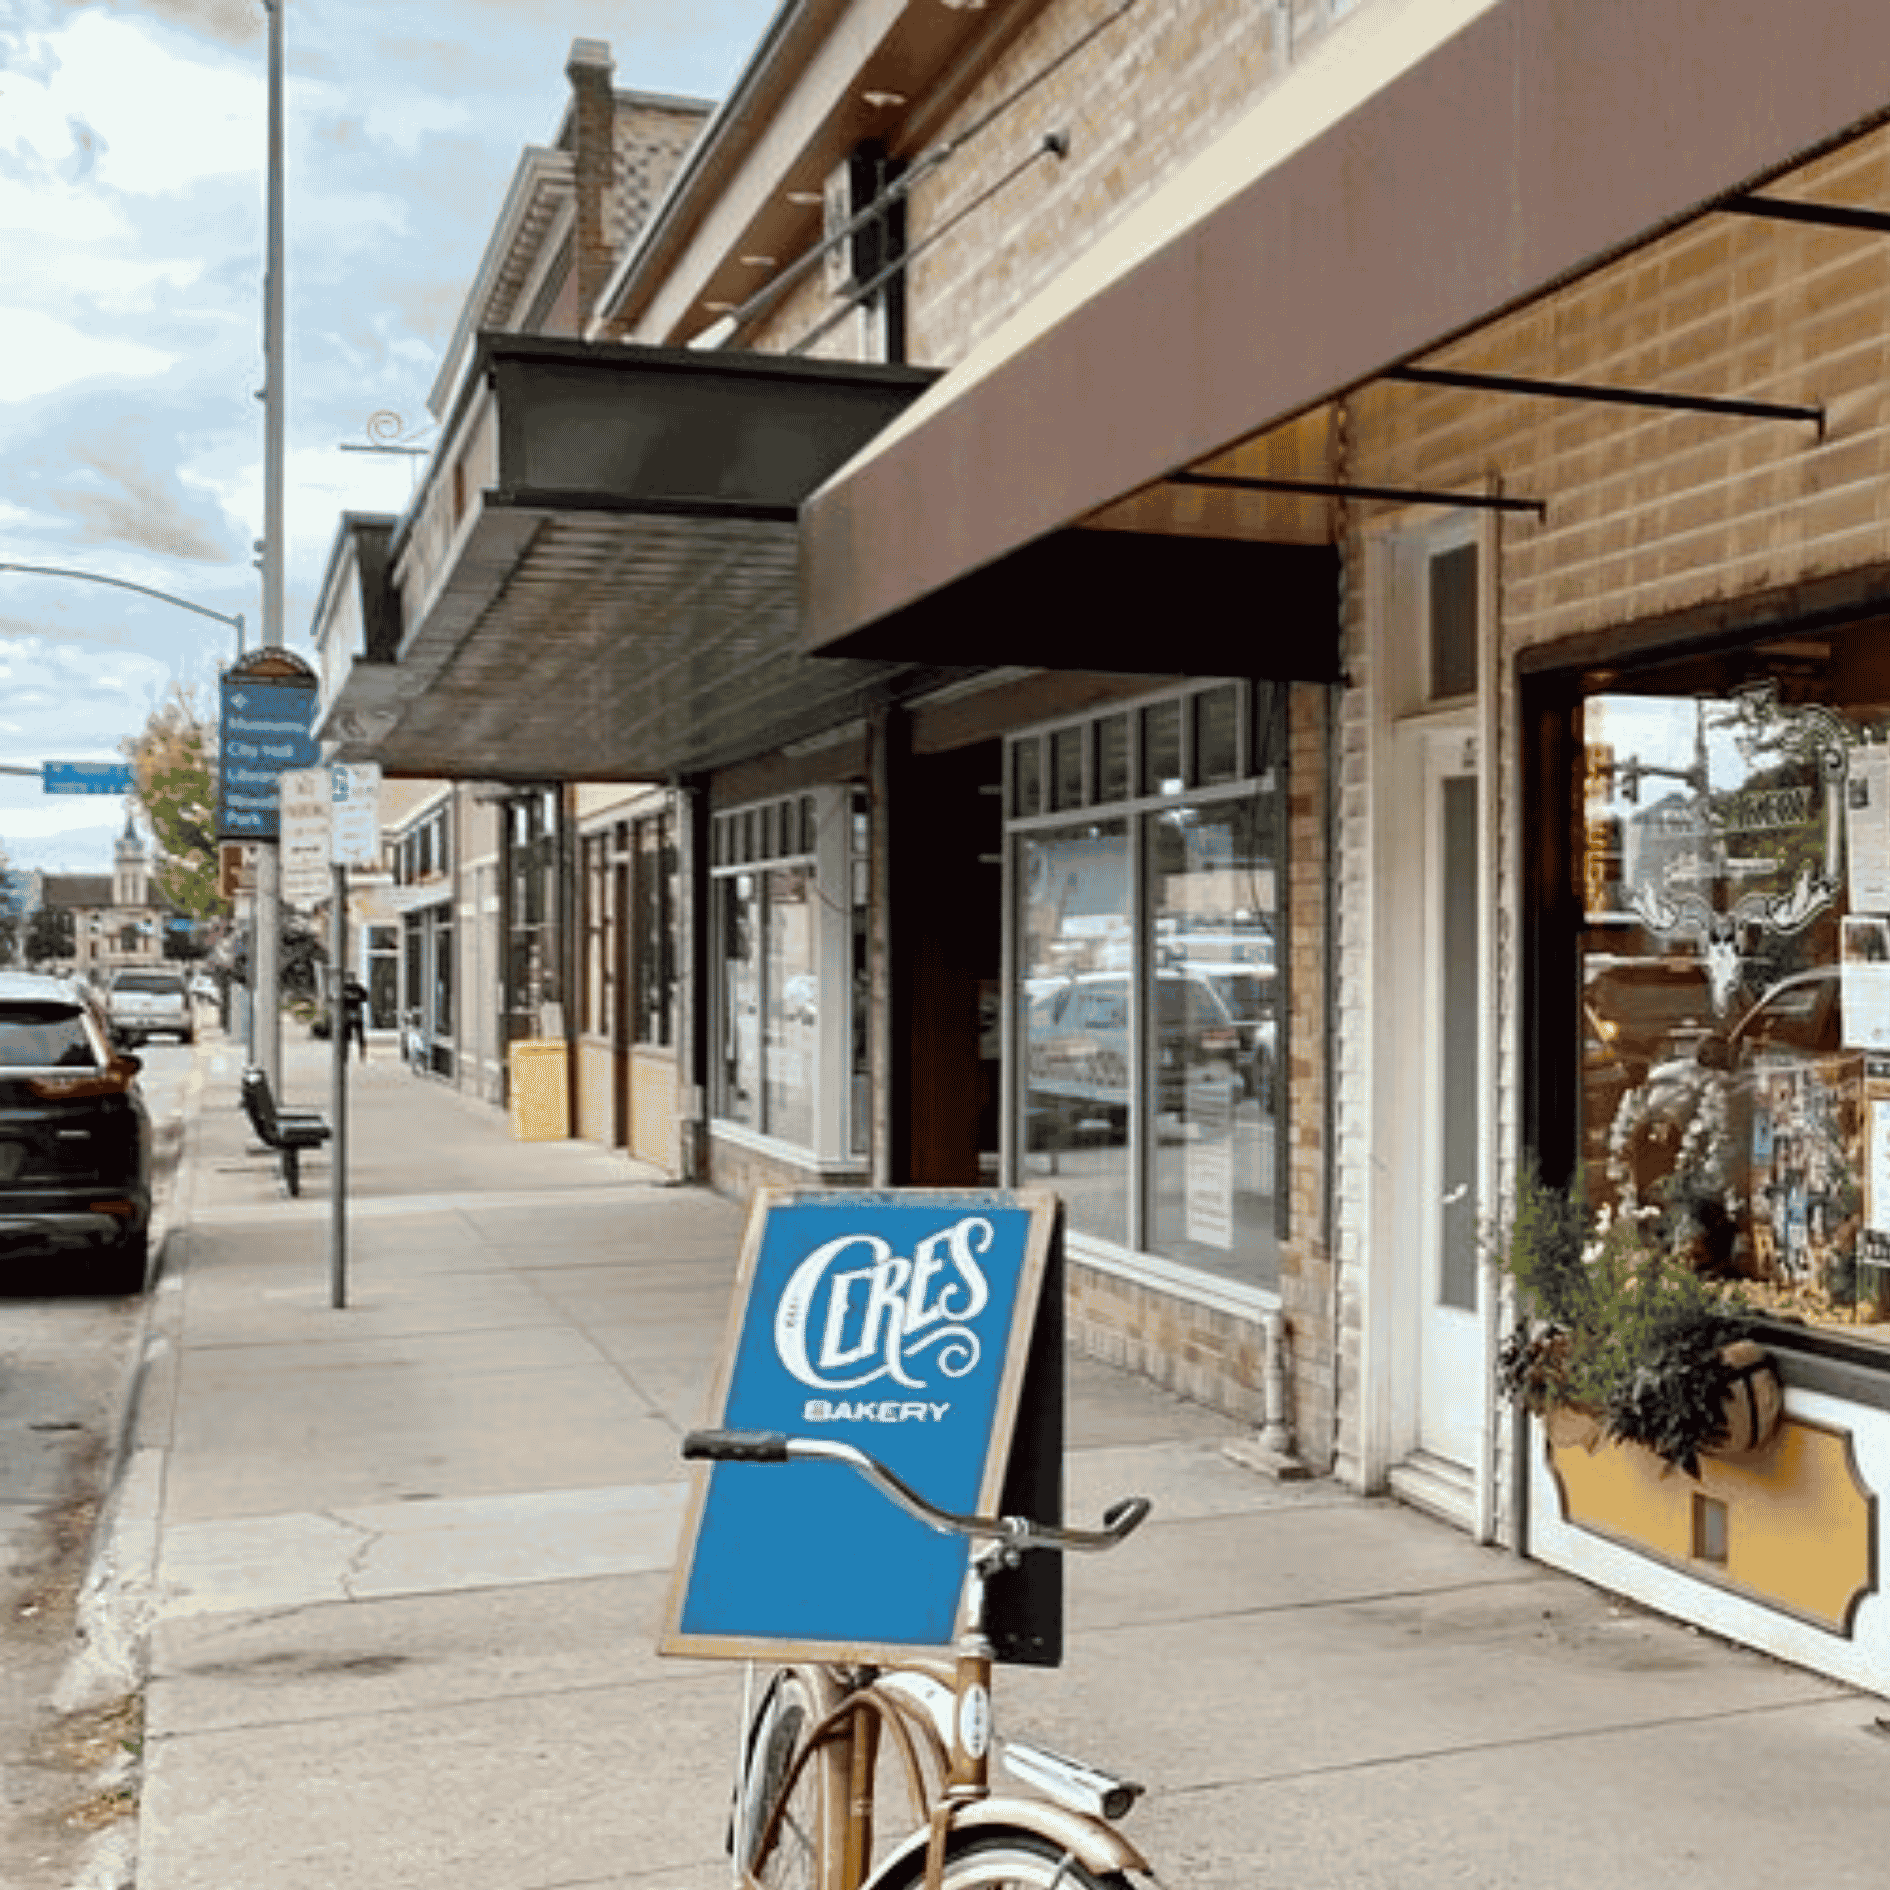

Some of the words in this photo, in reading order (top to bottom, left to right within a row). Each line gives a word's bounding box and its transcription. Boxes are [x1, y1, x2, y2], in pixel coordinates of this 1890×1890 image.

[227, 742, 258, 758] City
[261, 743, 294, 757] Hall
[226, 810, 261, 826] Park
[803, 1398, 952, 1423] BAKERY
